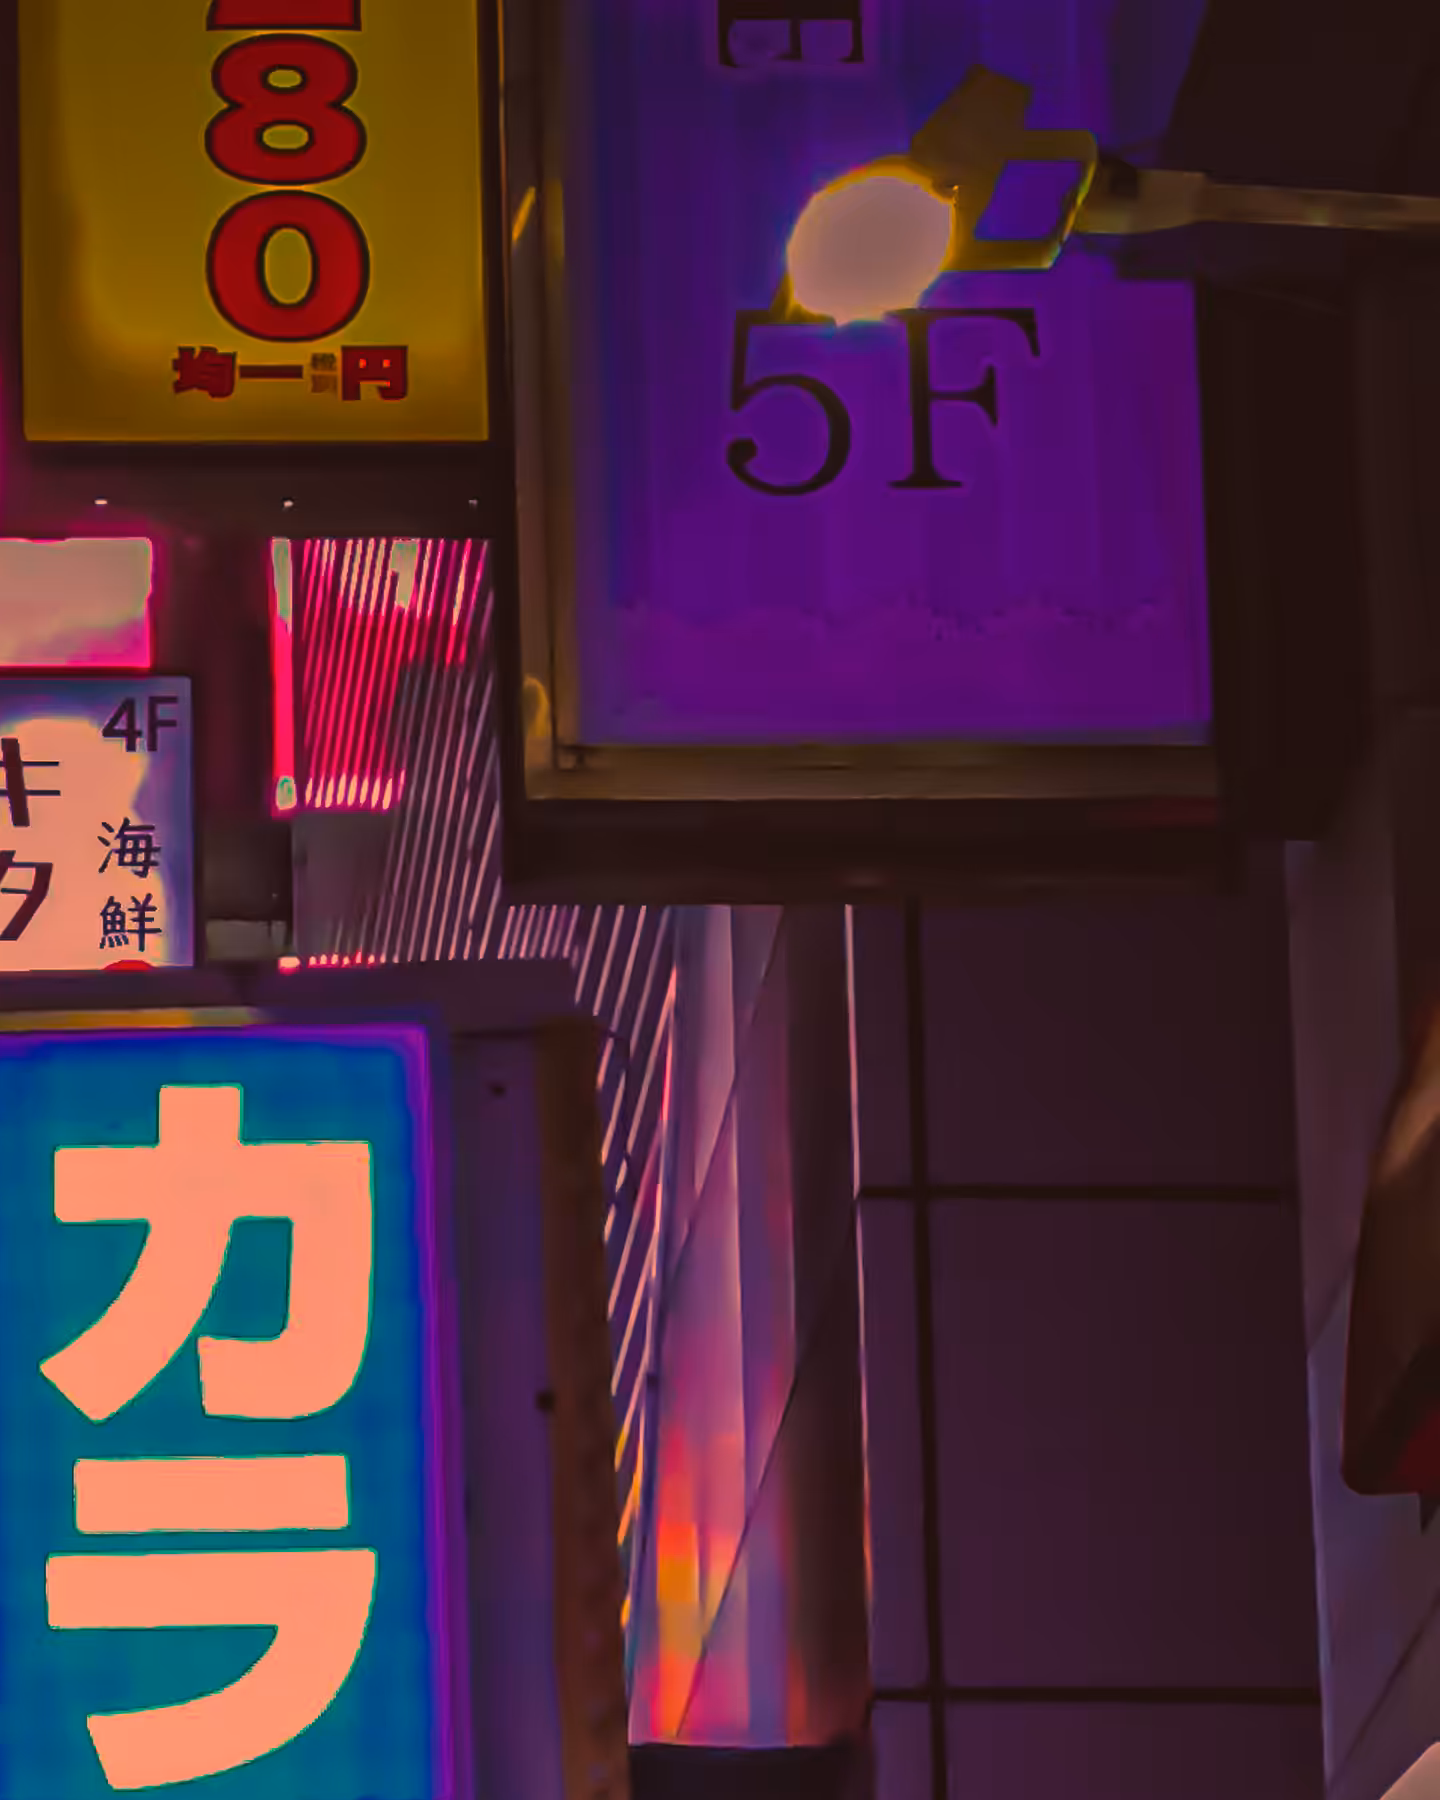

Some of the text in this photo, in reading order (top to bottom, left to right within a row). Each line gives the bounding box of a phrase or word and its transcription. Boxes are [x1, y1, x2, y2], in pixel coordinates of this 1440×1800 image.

[204, 0, 370, 343] 80
[725, 308, 1040, 496] 5F
[102, 696, 179, 752] 4F
[97, 817, 162, 952] 海鮮
